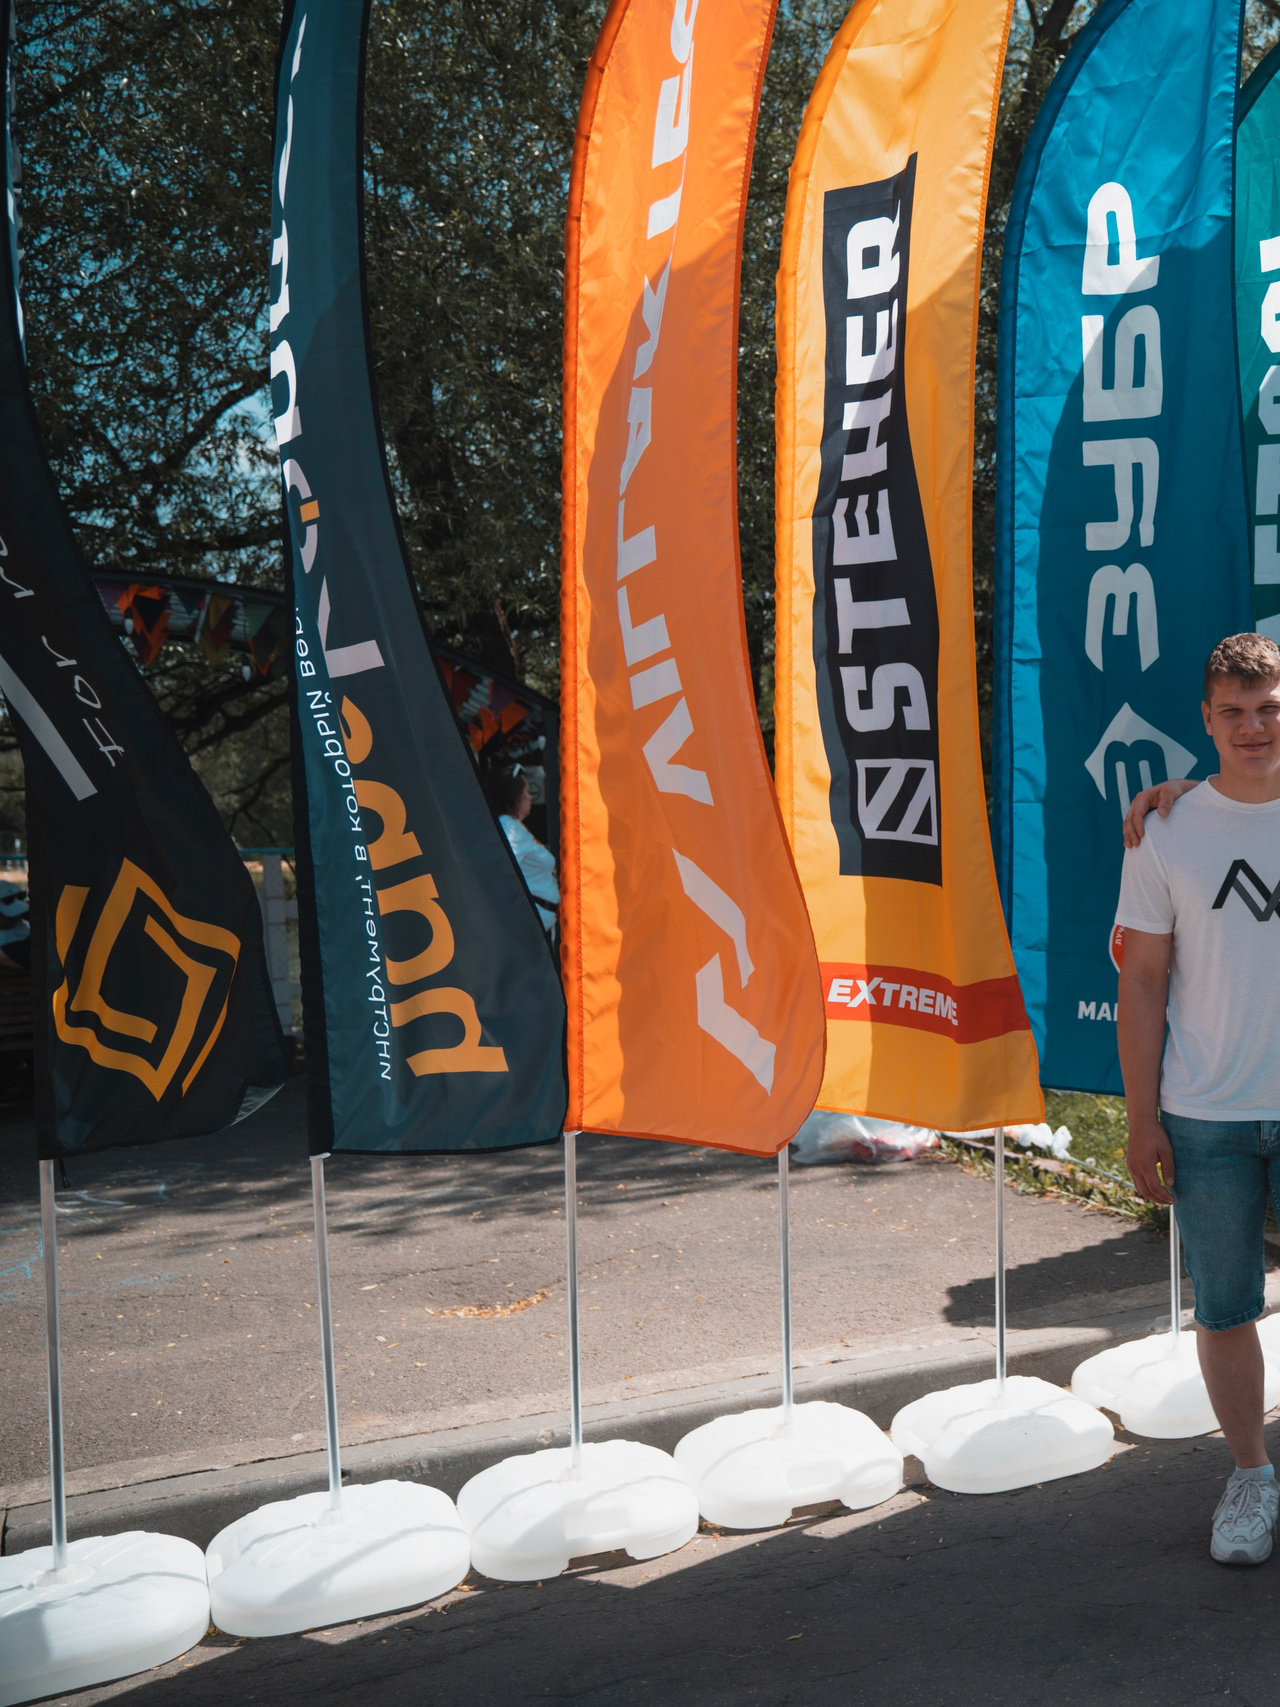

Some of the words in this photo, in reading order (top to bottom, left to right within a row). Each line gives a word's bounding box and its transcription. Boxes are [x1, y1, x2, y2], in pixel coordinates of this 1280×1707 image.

[832, 199, 931, 731] STEHER
[1082, 182, 1163, 672] ЗУБР
[828, 977, 958, 1027] EXTREME
